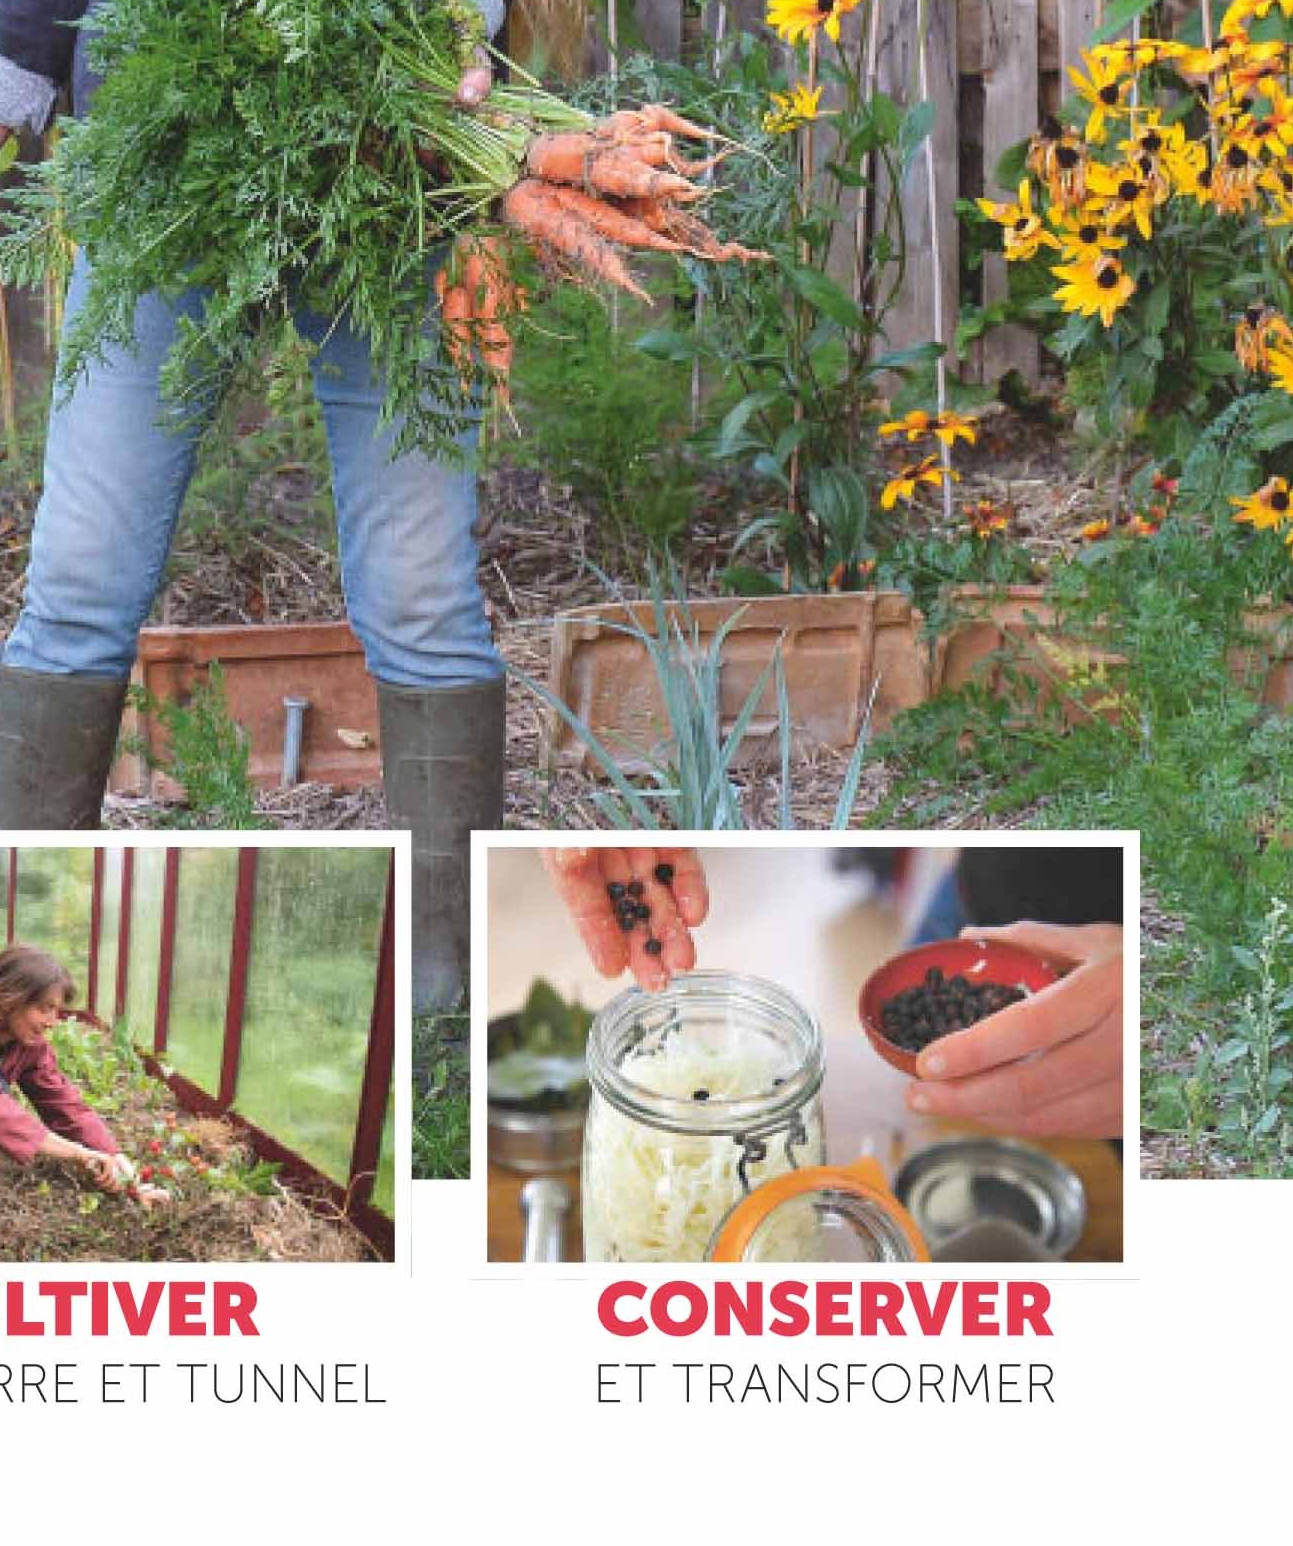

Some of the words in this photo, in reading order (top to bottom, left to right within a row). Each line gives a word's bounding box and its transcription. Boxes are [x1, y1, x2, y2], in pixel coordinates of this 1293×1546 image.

[598, 1281, 1053, 1336] CONSERVER
[103, 1364, 158, 1402] ET
[177, 1364, 386, 1403] TUNNEL
[598, 1364, 656, 1402] ET
[673, 1363, 1054, 1403] TRANSFORMER
